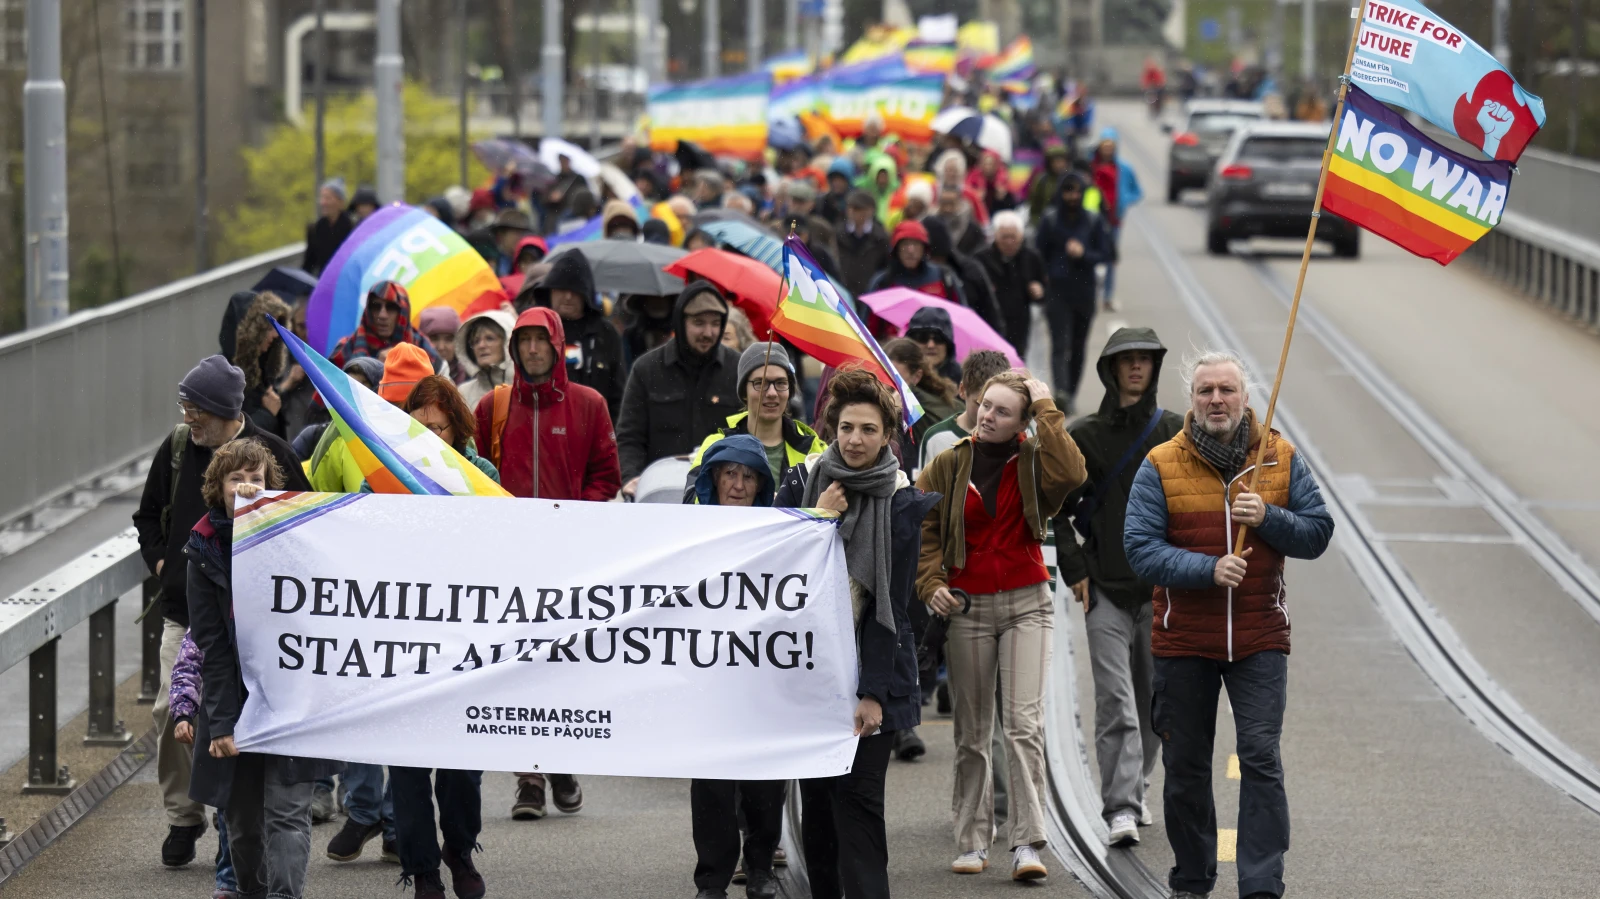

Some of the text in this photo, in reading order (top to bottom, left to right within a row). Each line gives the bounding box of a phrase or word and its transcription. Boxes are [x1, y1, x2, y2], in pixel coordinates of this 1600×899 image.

[1368, 1, 1462, 49] TRIKE FOR
[1360, 30, 1413, 59] UTURE
[1377, 63, 1390, 72] FÜR
[1336, 109, 1506, 226] NO WAR
[278, 633, 441, 679] STATT
[465, 705, 612, 724] OSTERMARSCH
[466, 723, 612, 740] MARCHE DE PÂQUES
